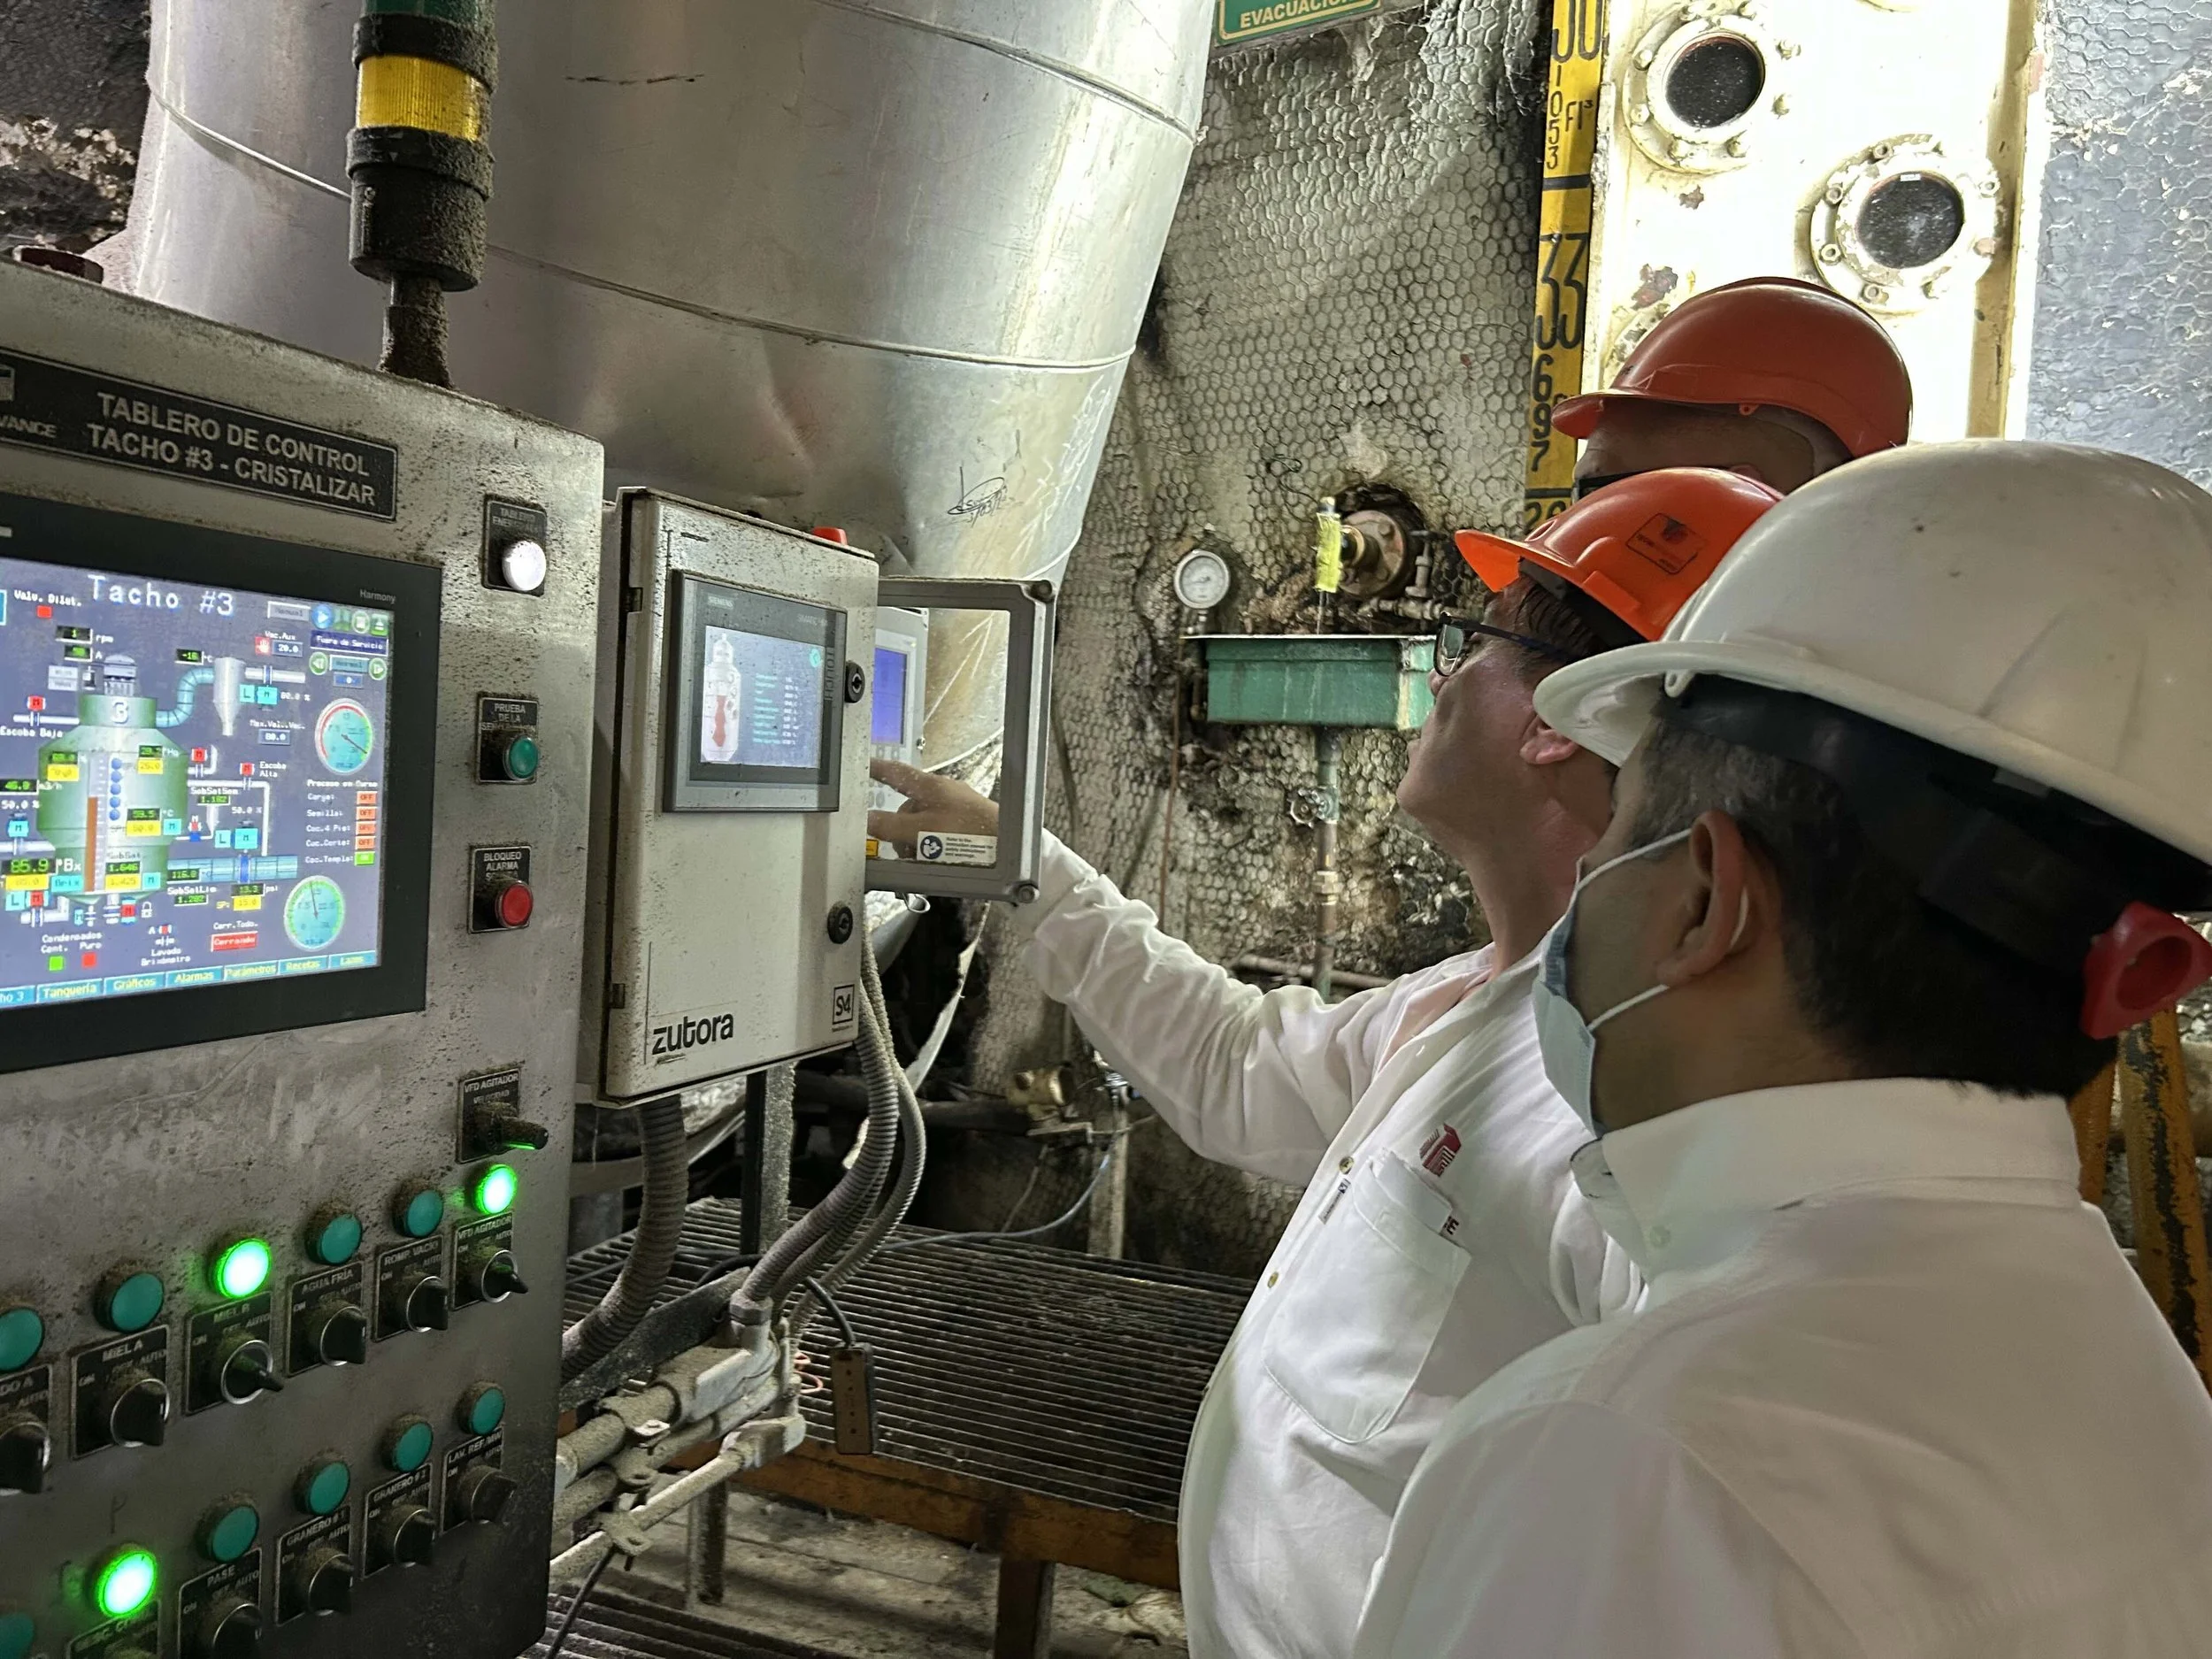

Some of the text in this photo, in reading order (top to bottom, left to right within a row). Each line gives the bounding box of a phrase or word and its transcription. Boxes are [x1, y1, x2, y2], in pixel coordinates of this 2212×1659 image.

[1240, 0, 1348, 28] EVACUACI
[1535, 232, 1588, 350] 33
[96, 391, 371, 477] TABLERO DE CONTROL
[87, 423, 179, 464] TACHO
[185, 445, 213, 472] #3
[234, 457, 376, 507] CRISTALIZAR
[87, 573, 234, 616] Tacho #3
[359, 589, 396, 604] Harmony
[708, 595, 734, 610] SIEMENS
[316, 635, 338, 646] Fuera
[350, 639, 384, 650] Servicio
[825, 647, 835, 701] TOUCH
[242, 687, 251, 699] L
[494, 703, 526, 714] PRUEBA
[498, 712, 510, 722] DE
[0, 726, 64, 740] Escoba Baja
[259, 761, 287, 771] Escoba
[259, 770, 279, 779] Alta
[306, 779, 341, 787] Proceso
[355, 780, 379, 788] Curso
[483, 851, 522, 862] BLOQUEO
[486, 861, 519, 872] ALARMA
[264, 886, 279, 895] psi
[11, 895, 19, 906] L
[42, 931, 103, 943] Condensados
[79, 941, 103, 951] Puro
[150, 947, 182, 957] Lavado
[225, 964, 277, 978] Parámetros
[285, 960, 321, 972] Recetas
[112, 977, 157, 991] Gráficos
[173, 970, 214, 984] Alarmas
[16, 991, 25, 1002] 3
[42, 982, 98, 998] Tanquería
[835, 993, 851, 1017] S4
[652, 1012, 734, 1056] zutora
[465, 1073, 518, 1093] VFD AGITADOR
[457, 1215, 512, 1240] VFD AGITADOR
[301, 1277, 330, 1295] AGUA
[213, 1307, 240, 1324] MIEL
[103, 1339, 143, 1363] MIEL A
[373, 1476, 413, 1503] GRANERO
[287, 1517, 332, 1547] GRANERO
[207, 1564, 235, 1588] PASE
[235, 1570, 260, 1589] AUTO
